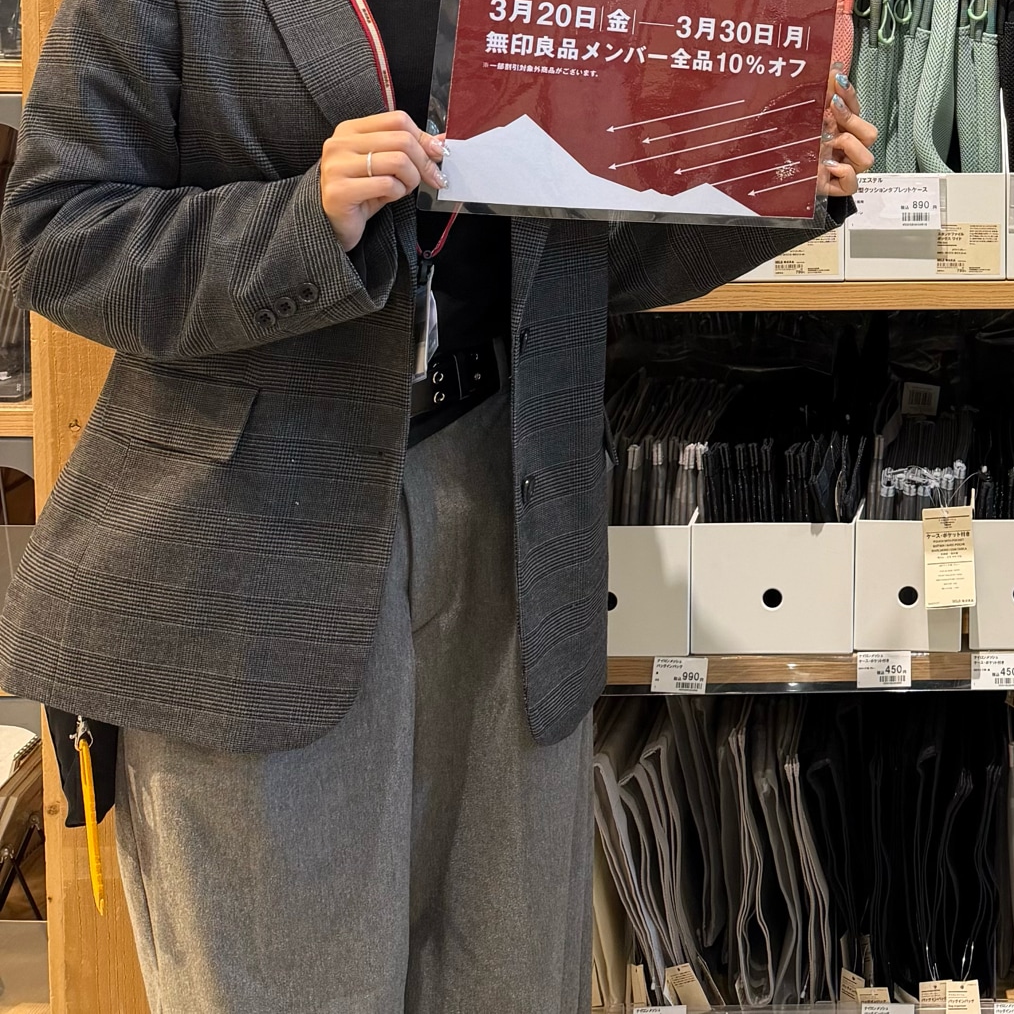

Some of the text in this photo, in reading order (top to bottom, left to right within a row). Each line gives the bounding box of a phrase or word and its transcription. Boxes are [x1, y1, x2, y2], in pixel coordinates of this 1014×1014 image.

[485, 31, 807, 79] 無印良品メンバー全品10%オフ
[912, 200, 930, 209] 890
